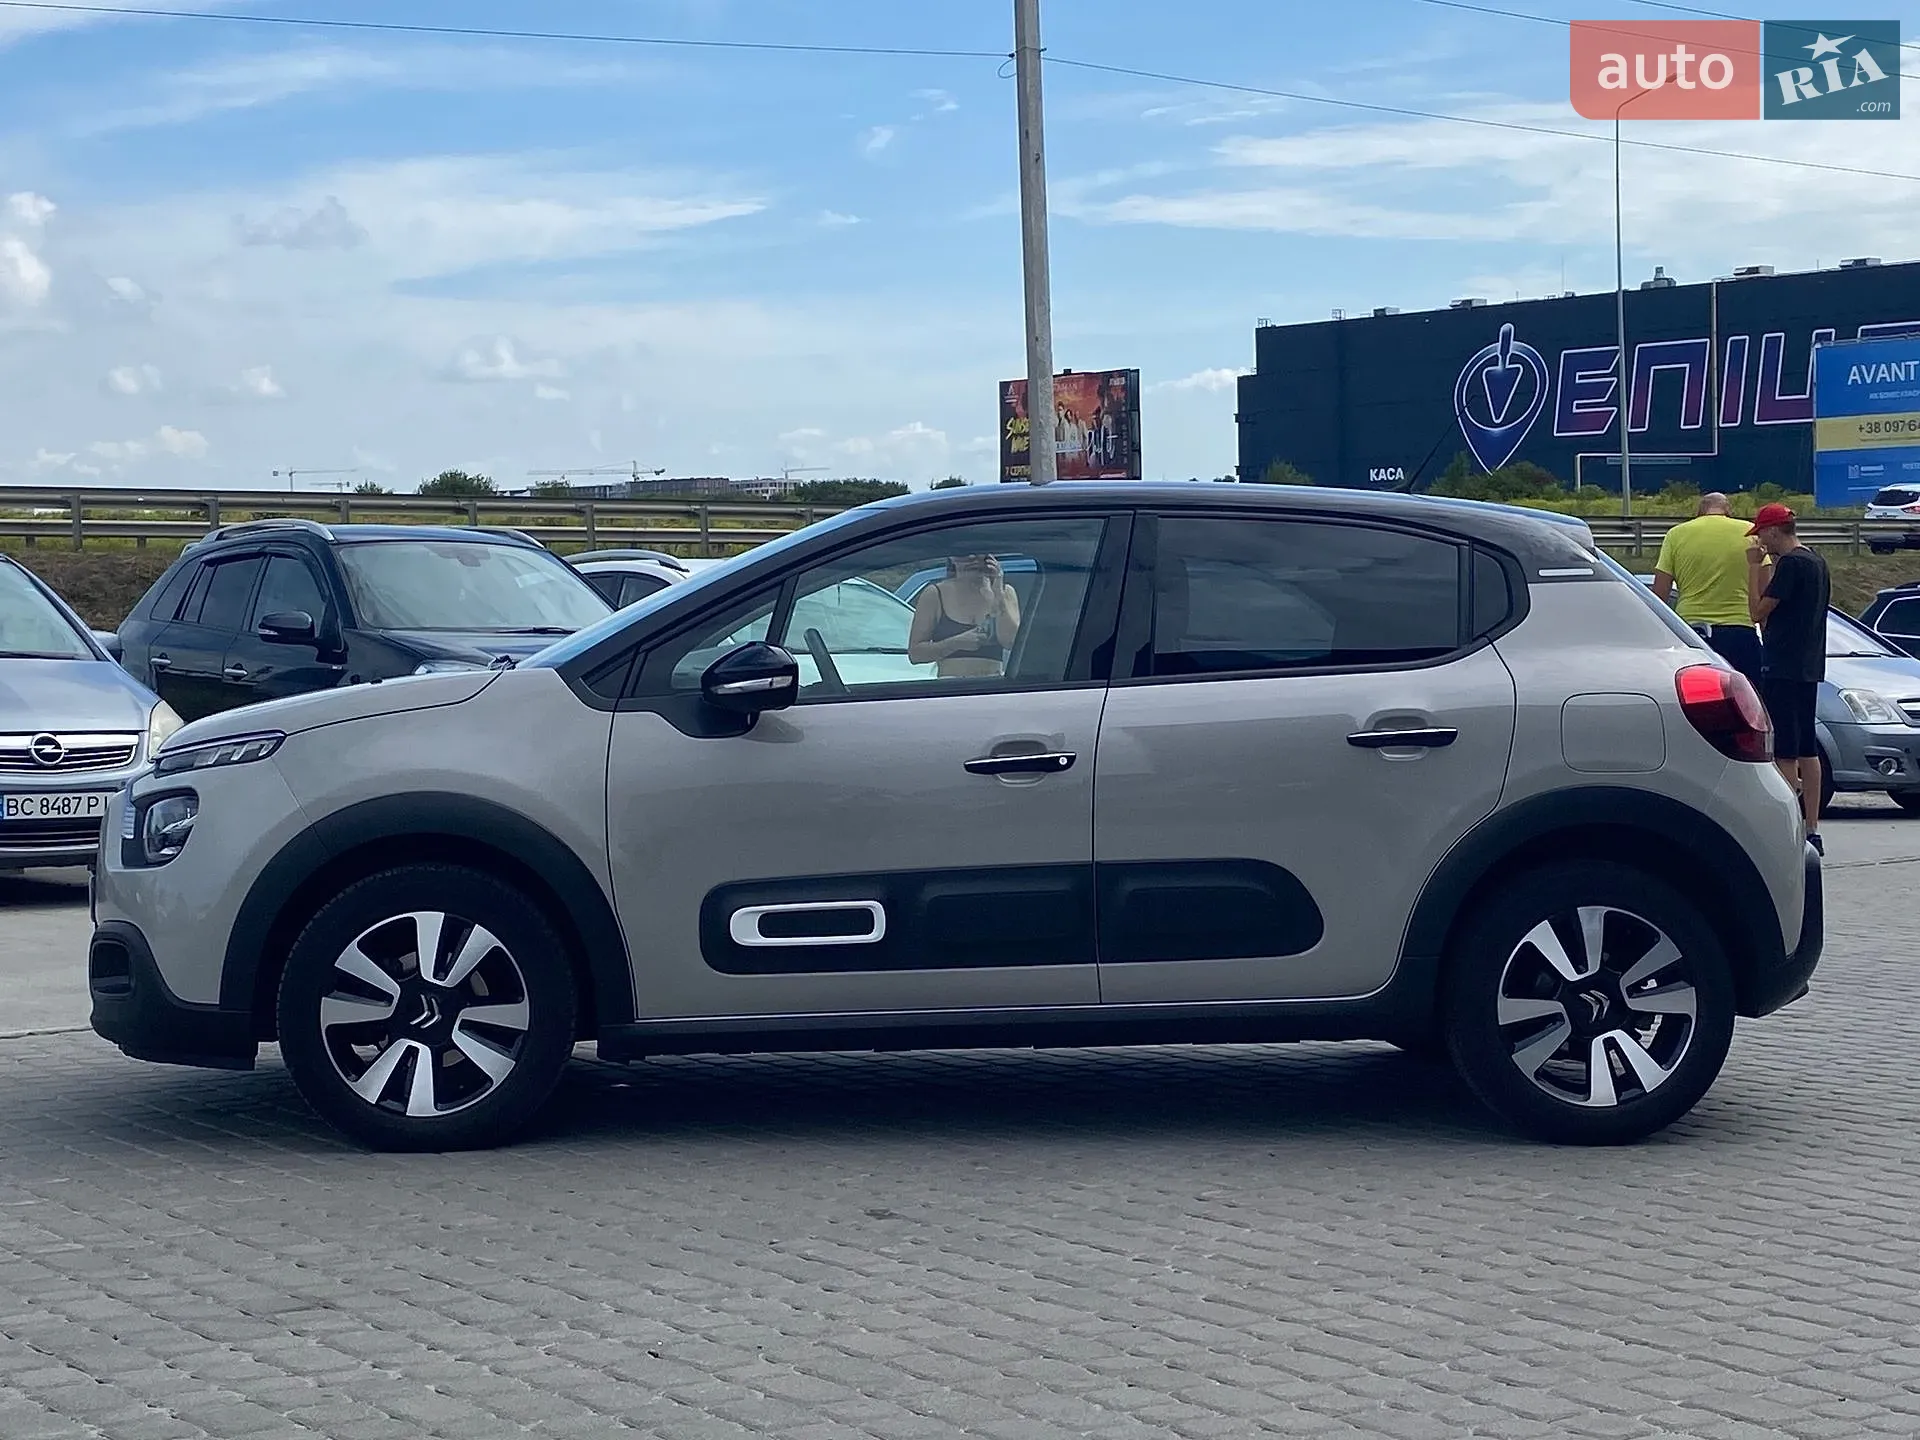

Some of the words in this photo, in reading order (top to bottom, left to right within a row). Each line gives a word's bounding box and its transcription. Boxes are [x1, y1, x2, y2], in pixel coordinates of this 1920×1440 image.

[1847, 361, 1920, 385] AVANT
[1858, 422, 1881, 434] +38
[1884, 420, 1905, 433] 097
[1908, 419, 1920, 432] 6
[1370, 468, 1404, 481] КАСА
[7, 798, 34, 817] BC
[40, 796, 82, 815] 8487
